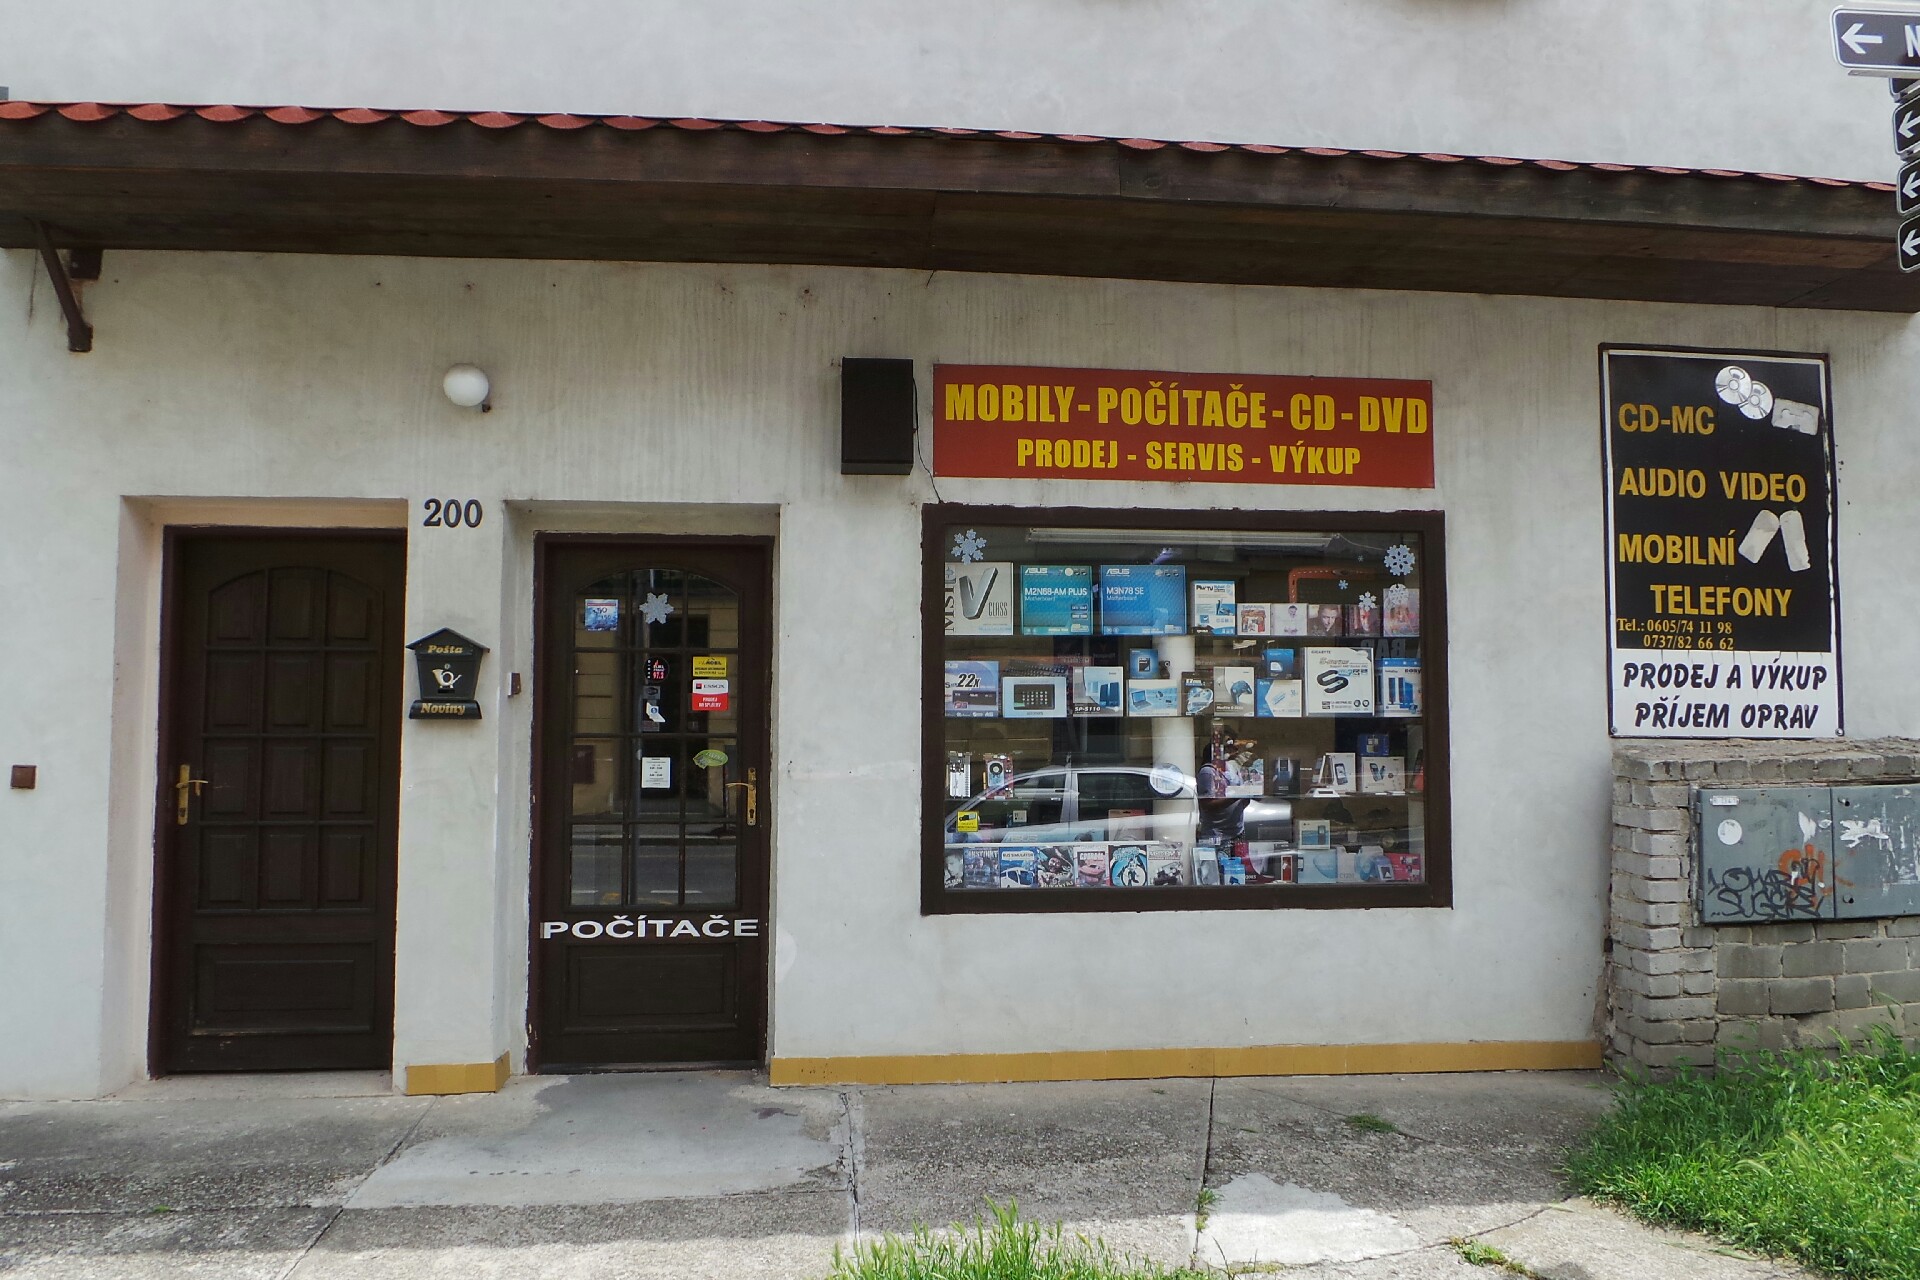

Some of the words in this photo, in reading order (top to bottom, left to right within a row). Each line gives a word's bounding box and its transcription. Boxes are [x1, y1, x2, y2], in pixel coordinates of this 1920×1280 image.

[1618, 402, 1715, 435] CD-MC
[1017, 438, 1118, 469] PRODEJ
[1145, 440, 1244, 472] SERVIS
[1269, 440, 1361, 475] VÝKUP
[1619, 467, 1706, 499] AUDIO
[1719, 471, 1806, 503] VIDEO
[423, 498, 483, 528] 200
[1618, 529, 1736, 566] MOBILNÍ
[1650, 584, 1792, 617] TELEFONY
[1643, 634, 1692, 650] 0737/82
[1698, 636, 1713, 650] 66
[1719, 637, 1734, 651] 62
[1647, 619, 1694, 634] 0605/74
[1699, 622, 1712, 634] 11
[1717, 622, 1732, 634] 98
[1623, 662, 1720, 690] PRODEJ
[1726, 664, 1742, 690] A
[1751, 658, 1828, 691] VÝKUP
[421, 702, 466, 716] Noviny
[1635, 694, 1730, 730] PŘÍJEM
[1740, 703, 1819, 731] OPRAV
[540, 914, 759, 939] POČÍTAČE
